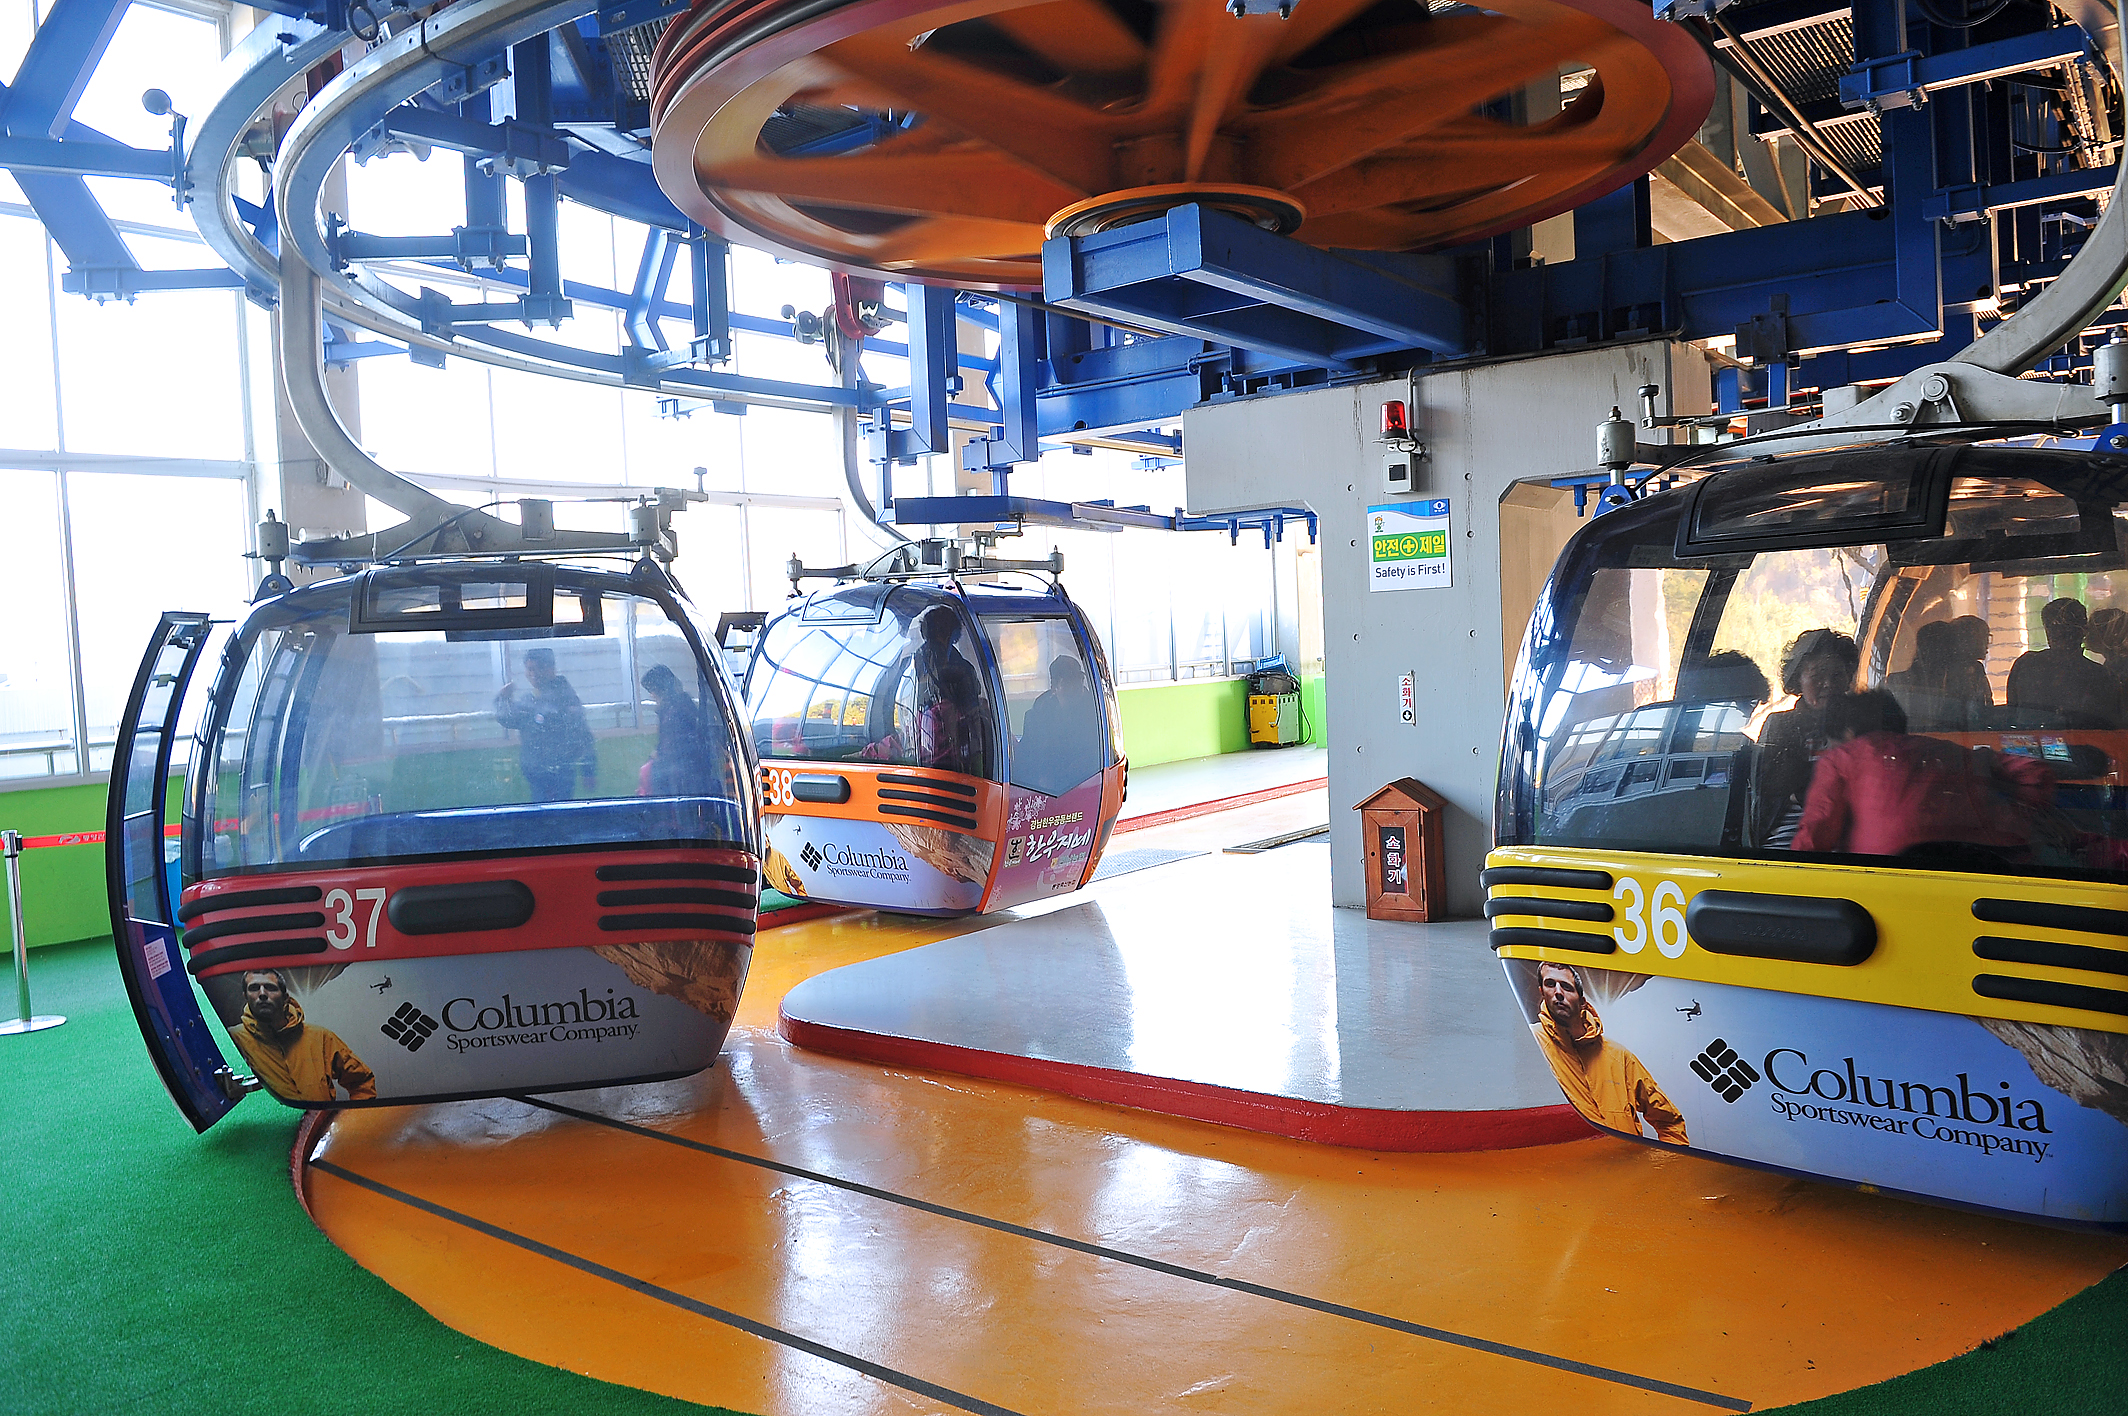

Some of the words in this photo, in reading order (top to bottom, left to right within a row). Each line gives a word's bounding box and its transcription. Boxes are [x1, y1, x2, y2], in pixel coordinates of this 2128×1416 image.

[1374, 538, 1400, 558] 안전
[1420, 535, 1445, 554] 제일
[1375, 566, 1405, 579] Safety
[1407, 565, 1416, 576] is
[1418, 563, 1446, 576] First!
[1402, 677, 1412, 708] 소화기
[769, 769, 795, 806] 38
[823, 843, 909, 871] Columbia
[826, 864, 870, 879] Sportswear
[869, 868, 911, 885] Company
[1385, 836, 1402, 885] 소화기
[325, 887, 387, 950] 37
[1613, 876, 1689, 959] 36
[441, 987, 640, 1033] Columbia
[446, 1031, 548, 1054] Sportswear
[549, 1023, 639, 1044] Company
[1763, 1048, 2054, 1134] Columbia
[1770, 1092, 1910, 1136] Sportswear
[1911, 1116, 2051, 1164] Company
